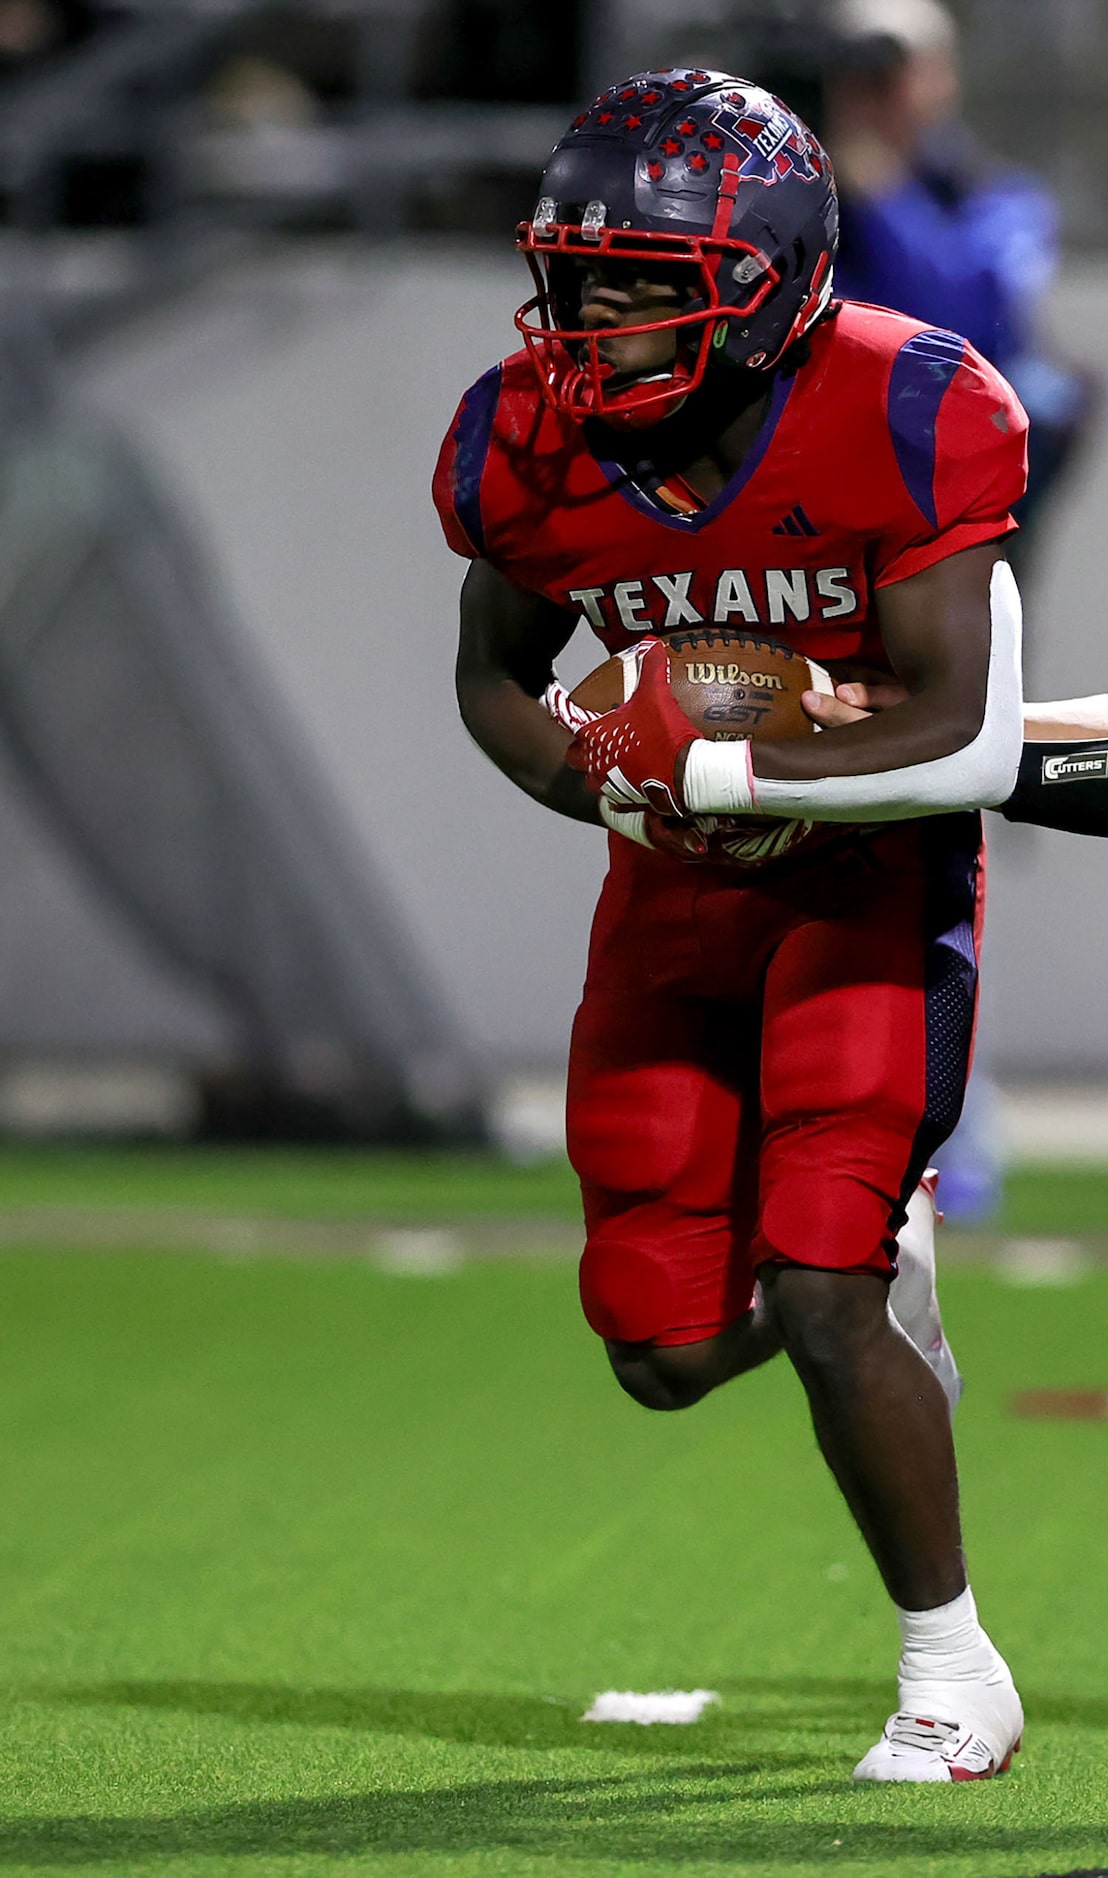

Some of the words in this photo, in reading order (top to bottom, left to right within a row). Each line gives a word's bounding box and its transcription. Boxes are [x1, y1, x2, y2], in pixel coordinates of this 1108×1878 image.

[752, 114, 791, 158] TEXANS
[569, 567, 858, 631] TEXANS
[686, 663, 784, 690] Wilson
[703, 704, 772, 725] GST
[1045, 756, 1103, 779] CUTTERS
